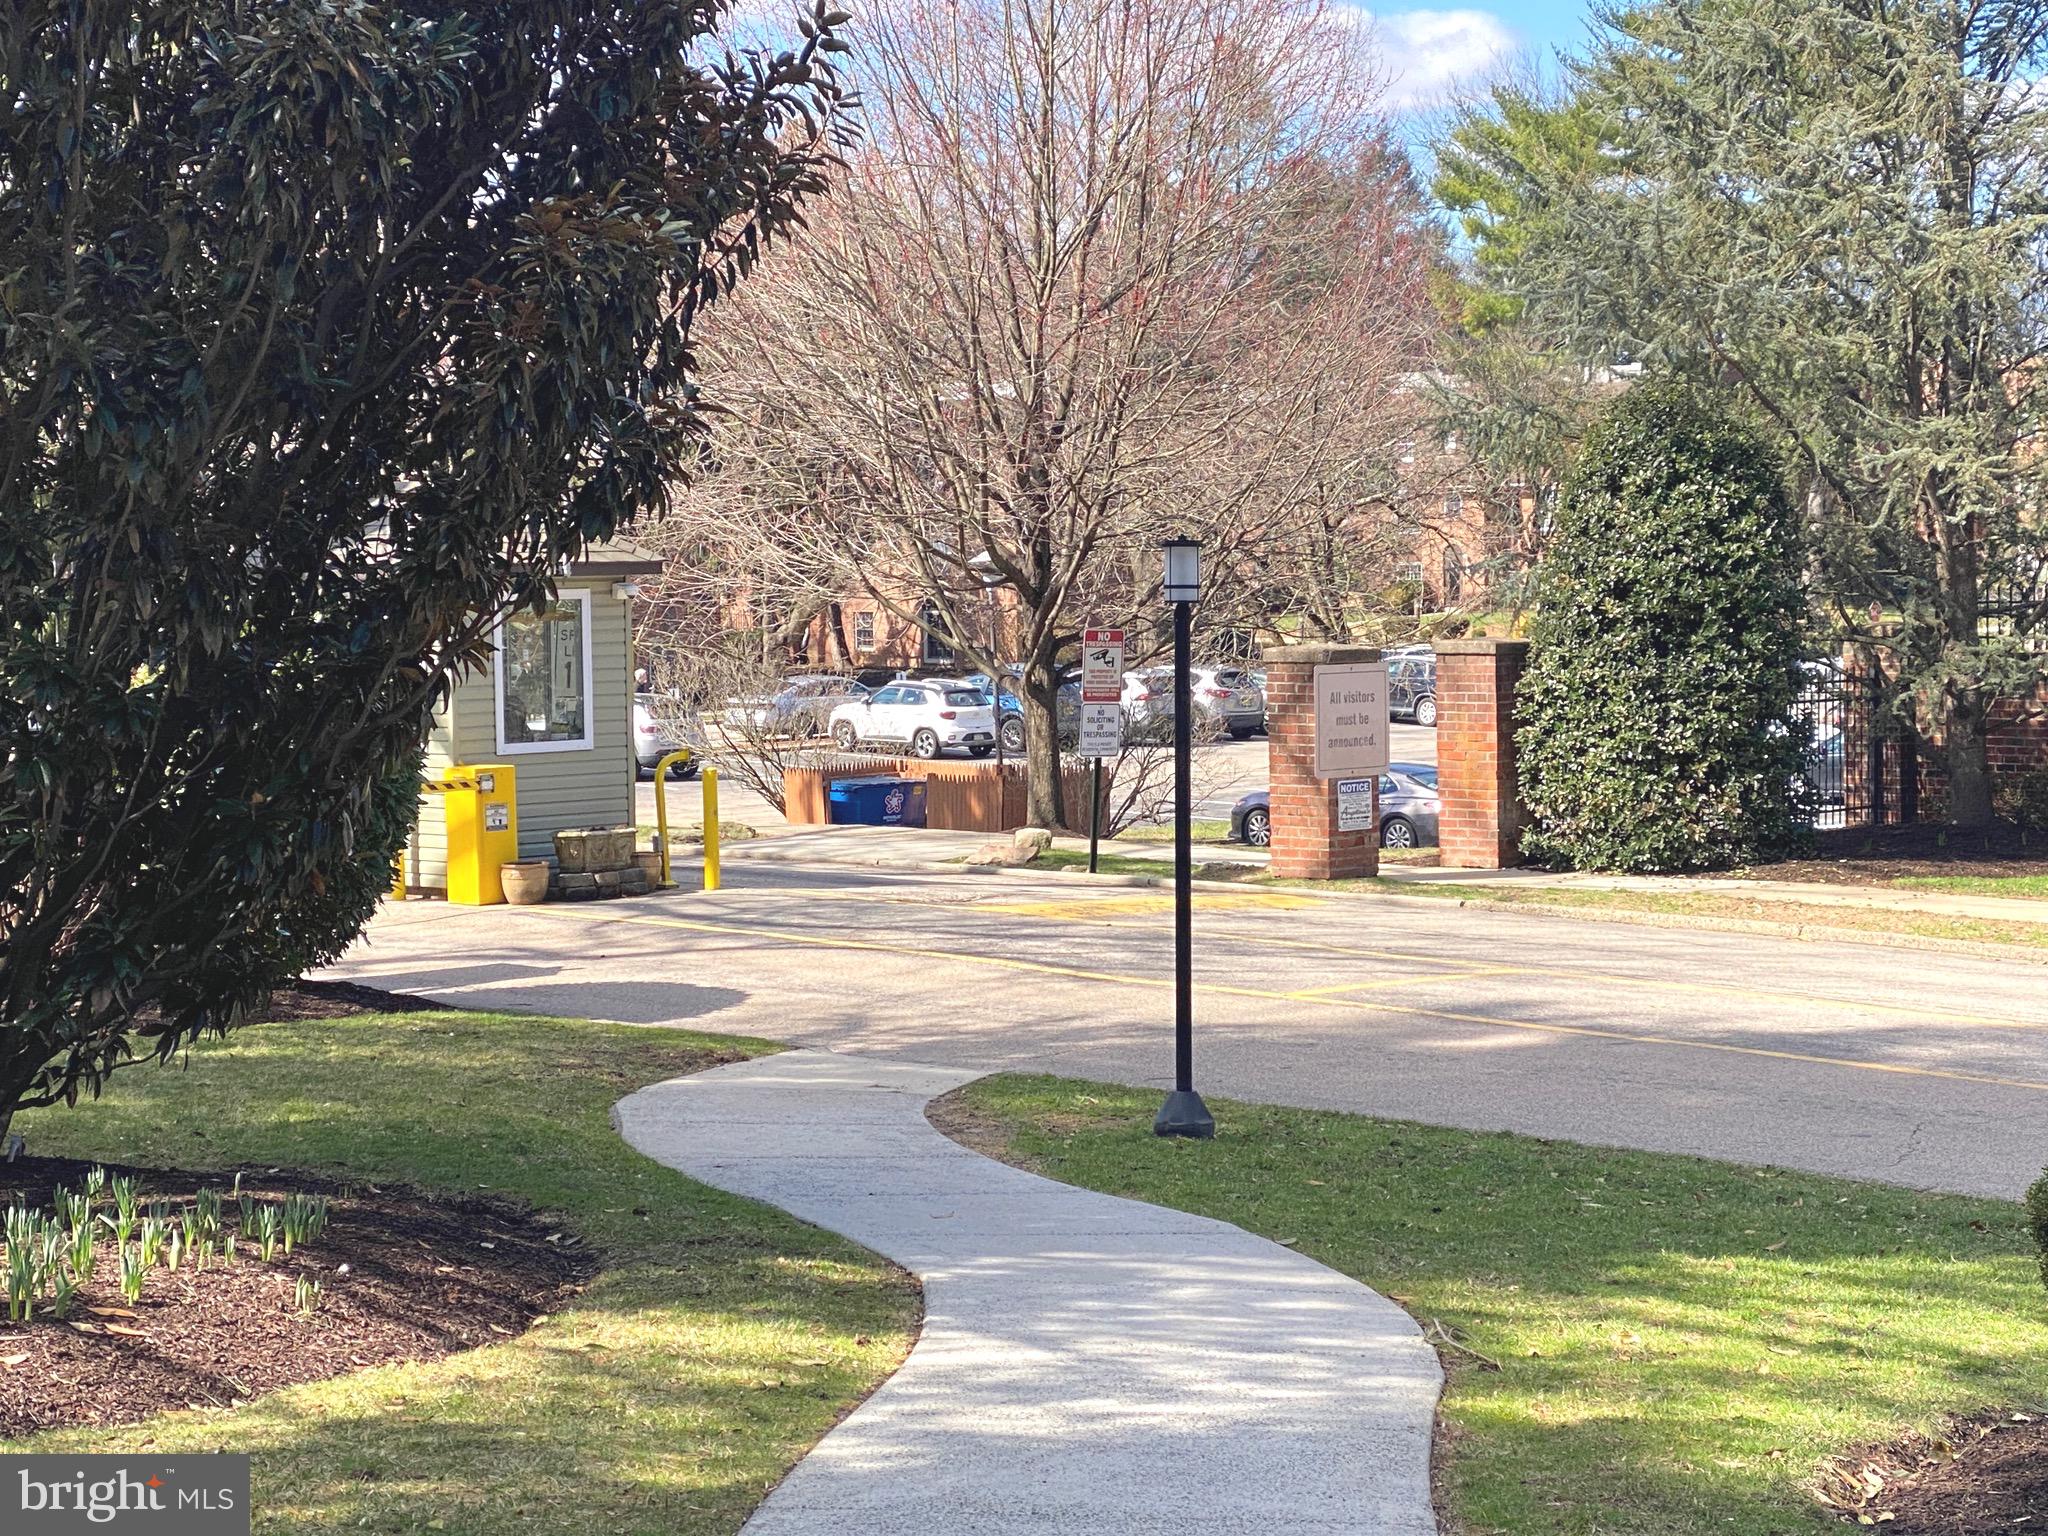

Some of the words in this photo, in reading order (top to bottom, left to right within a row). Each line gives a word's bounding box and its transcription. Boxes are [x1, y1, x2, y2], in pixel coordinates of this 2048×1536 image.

[1097, 631, 1111, 641] NO
[1329, 691, 1342, 705] All
[1343, 690, 1375, 704] visitors
[1335, 713, 1357, 726] must
[1358, 713, 1369, 725] be
[1328, 734, 1377, 749] announced.
[1340, 782, 1369, 793] NOTICE
